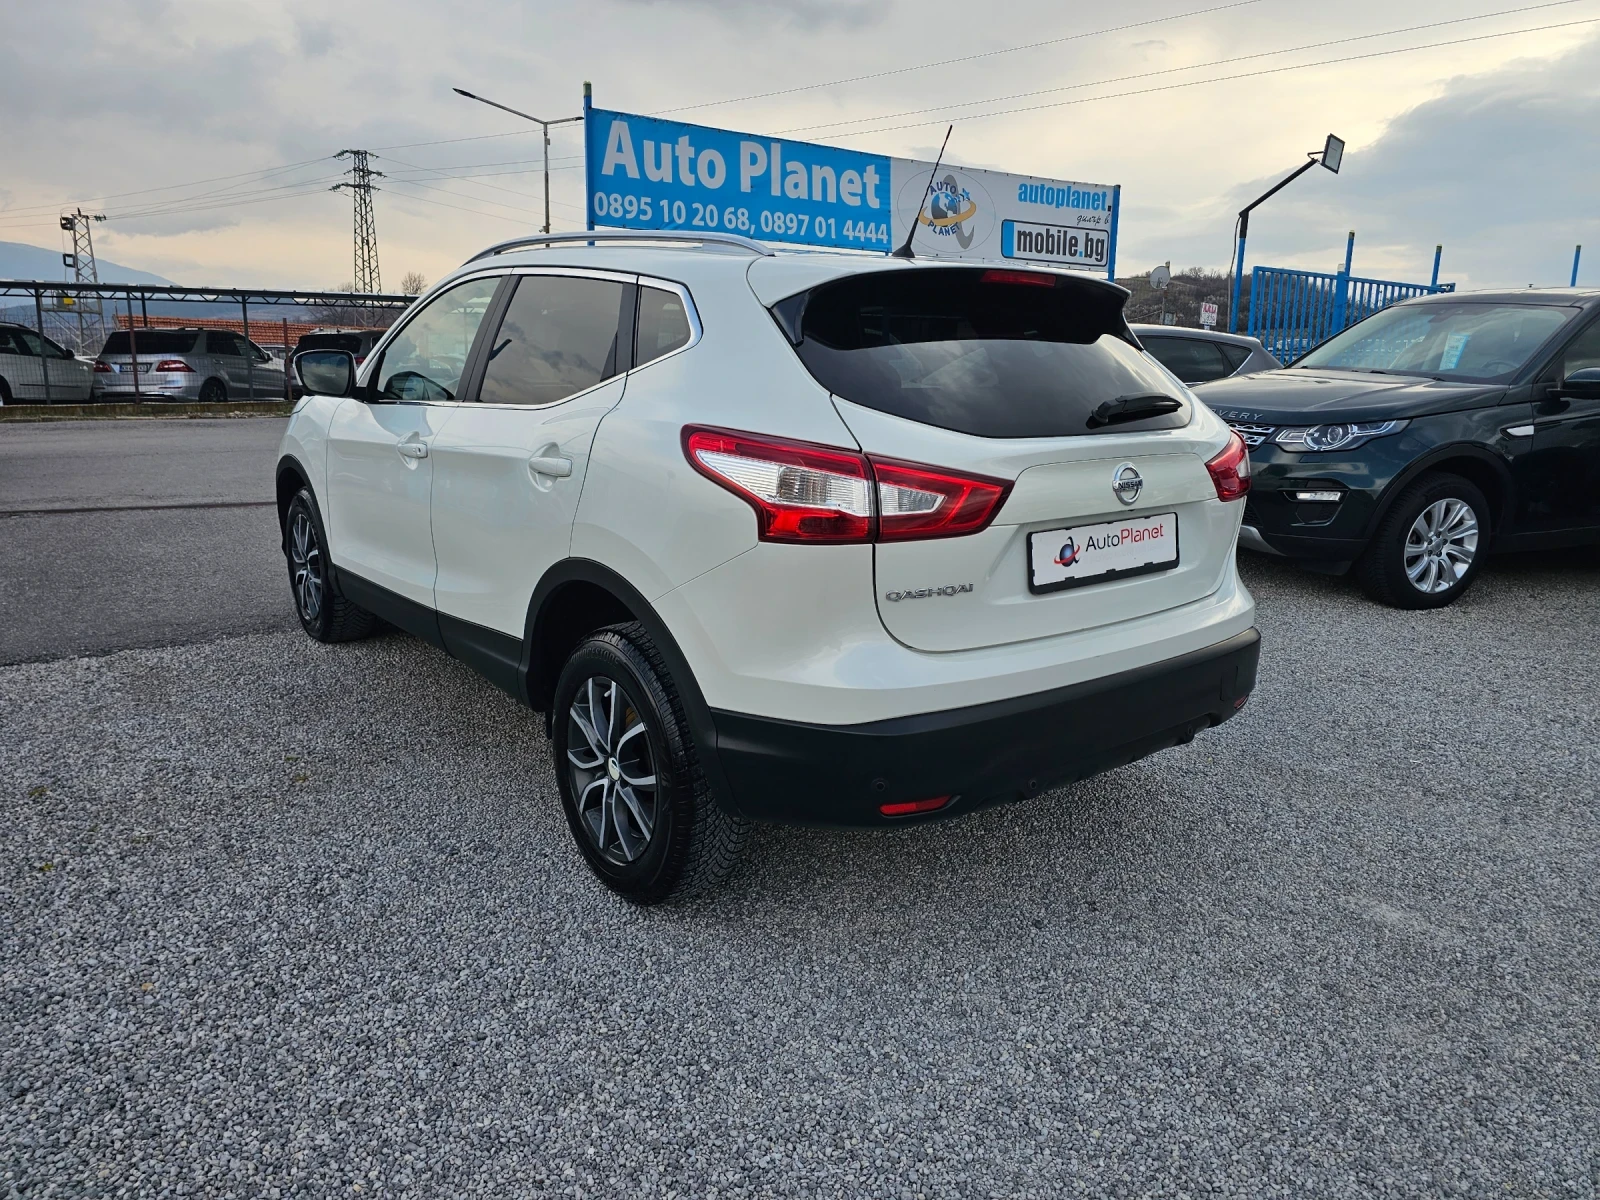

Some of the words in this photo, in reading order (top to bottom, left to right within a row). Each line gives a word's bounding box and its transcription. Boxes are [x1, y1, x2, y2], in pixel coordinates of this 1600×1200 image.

[601, 120, 727, 190] Auto
[740, 141, 880, 209] Planet
[930, 181, 957, 196] AUTO
[593, 191, 653, 221] 0895
[659, 199, 686, 224] 10
[692, 202, 719, 228] 20
[723, 206, 756, 235] 68,
[760, 210, 810, 236] 0897
[814, 215, 836, 239] 01
[842, 219, 889, 244] 4444
[928, 219, 960, 237] PLANET
[1016, 228, 1105, 263] mobile.bg
[1118, 479, 1142, 490] NISSAN
[1085, 522, 1164, 553] AutoPlanet
[885, 581, 974, 602] QASHQAI
